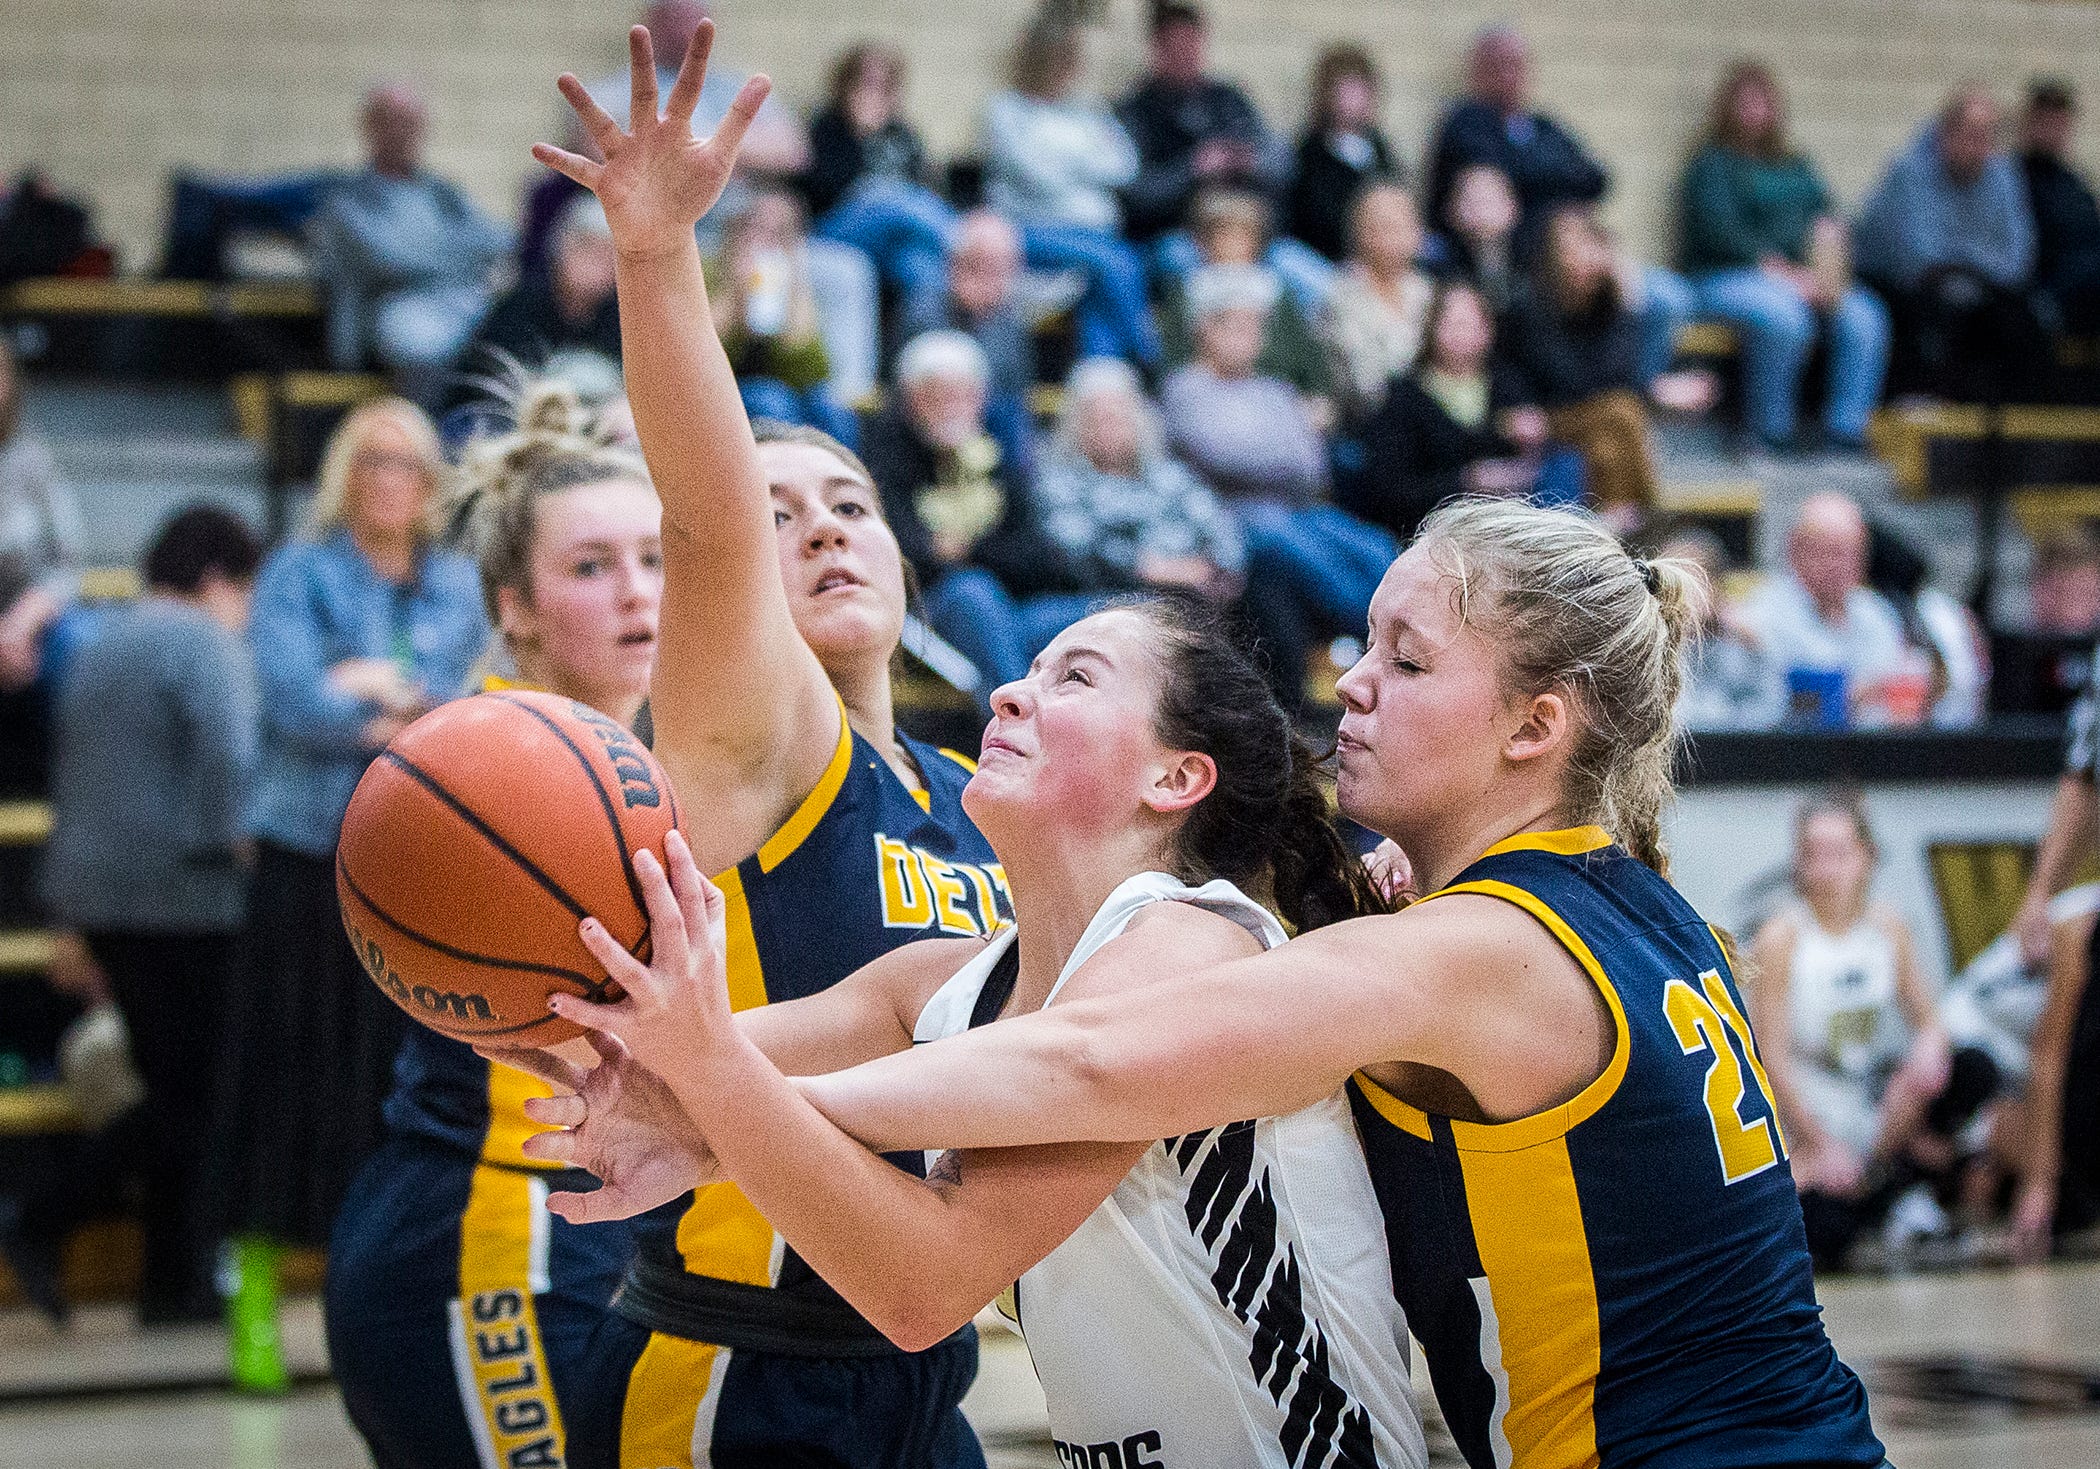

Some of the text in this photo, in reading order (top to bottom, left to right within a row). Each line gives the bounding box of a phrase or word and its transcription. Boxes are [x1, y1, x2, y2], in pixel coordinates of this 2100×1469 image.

[347, 926, 502, 1021] lson
[1662, 967, 1790, 1187] 21
[472, 1288, 561, 1469] AGLES
